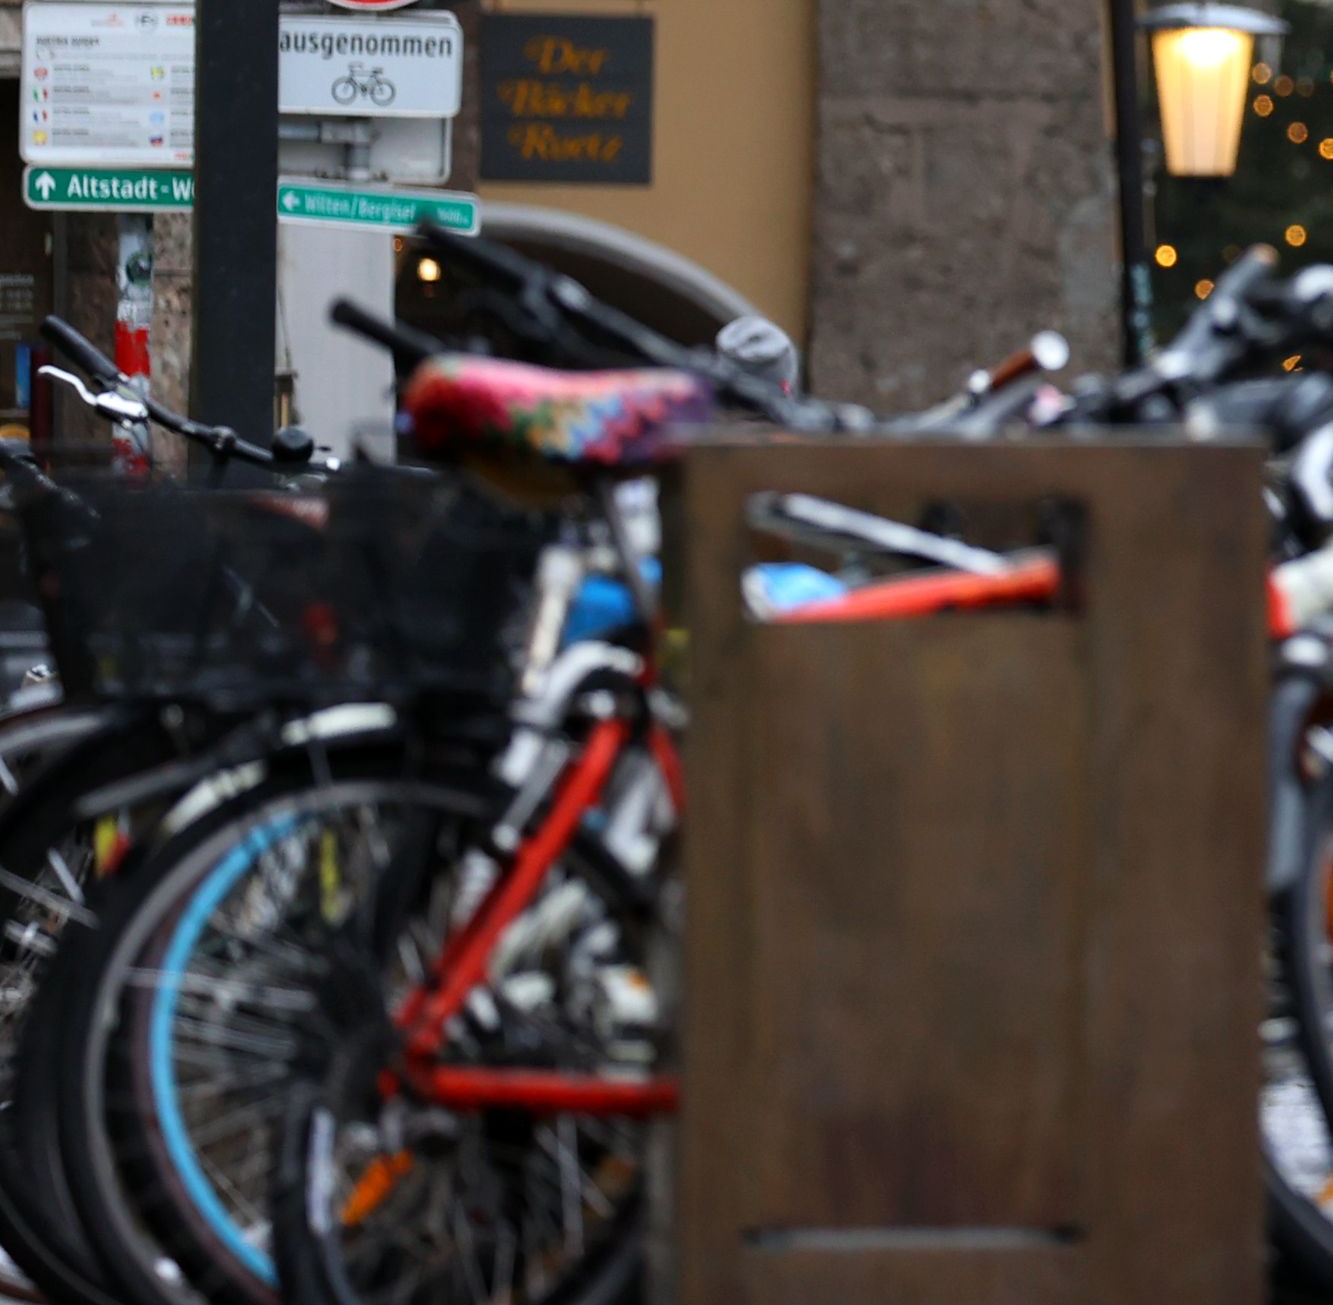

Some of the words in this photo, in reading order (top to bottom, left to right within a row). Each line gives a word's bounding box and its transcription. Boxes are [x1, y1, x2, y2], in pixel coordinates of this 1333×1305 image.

[278, 30, 453, 59] ausgenommen
[522, 34, 611, 74] Der
[67, 173, 195, 202] Altstadt-W
